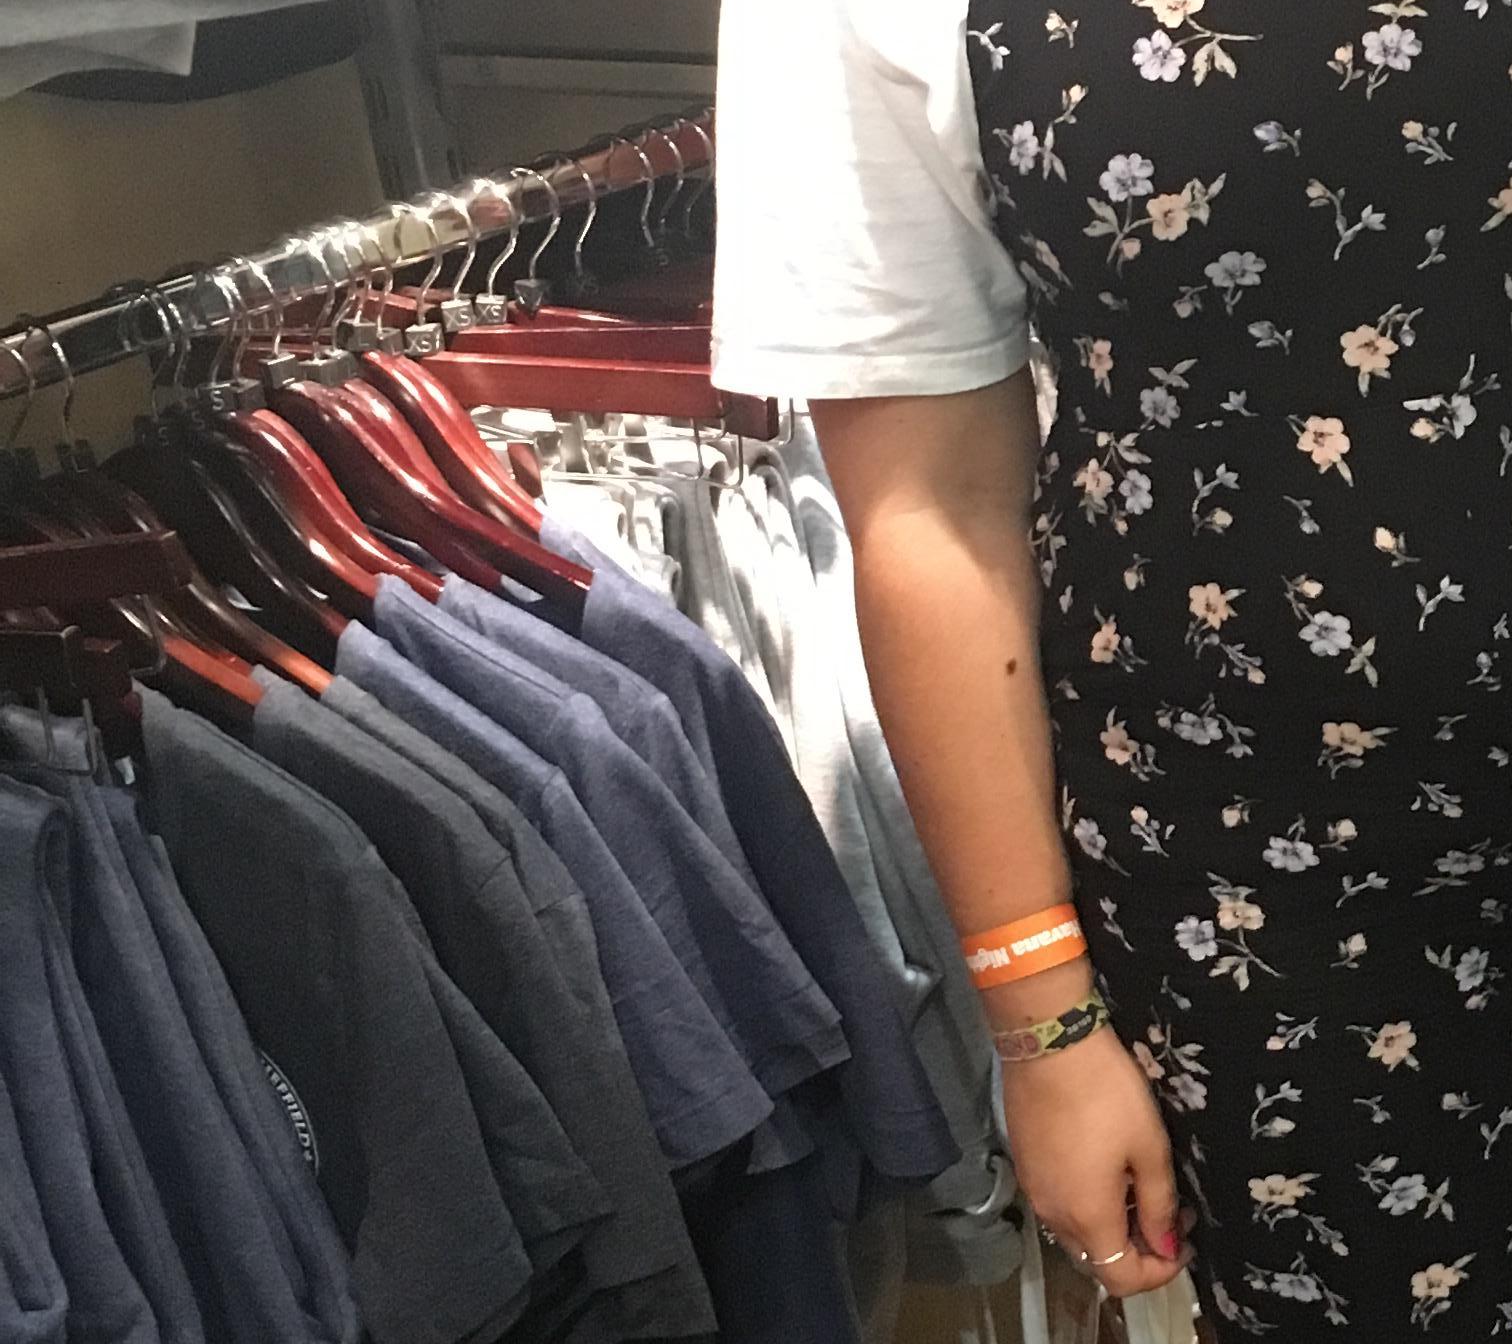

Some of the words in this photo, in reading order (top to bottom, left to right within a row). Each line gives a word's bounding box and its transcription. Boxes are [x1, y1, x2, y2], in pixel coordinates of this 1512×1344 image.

[446, 308, 472, 330] XS
[476, 305, 501, 324] XS
[404, 337, 433, 353] XS
[210, 389, 225, 411] S
[262, 1060, 311, 1147] EFFIELD
